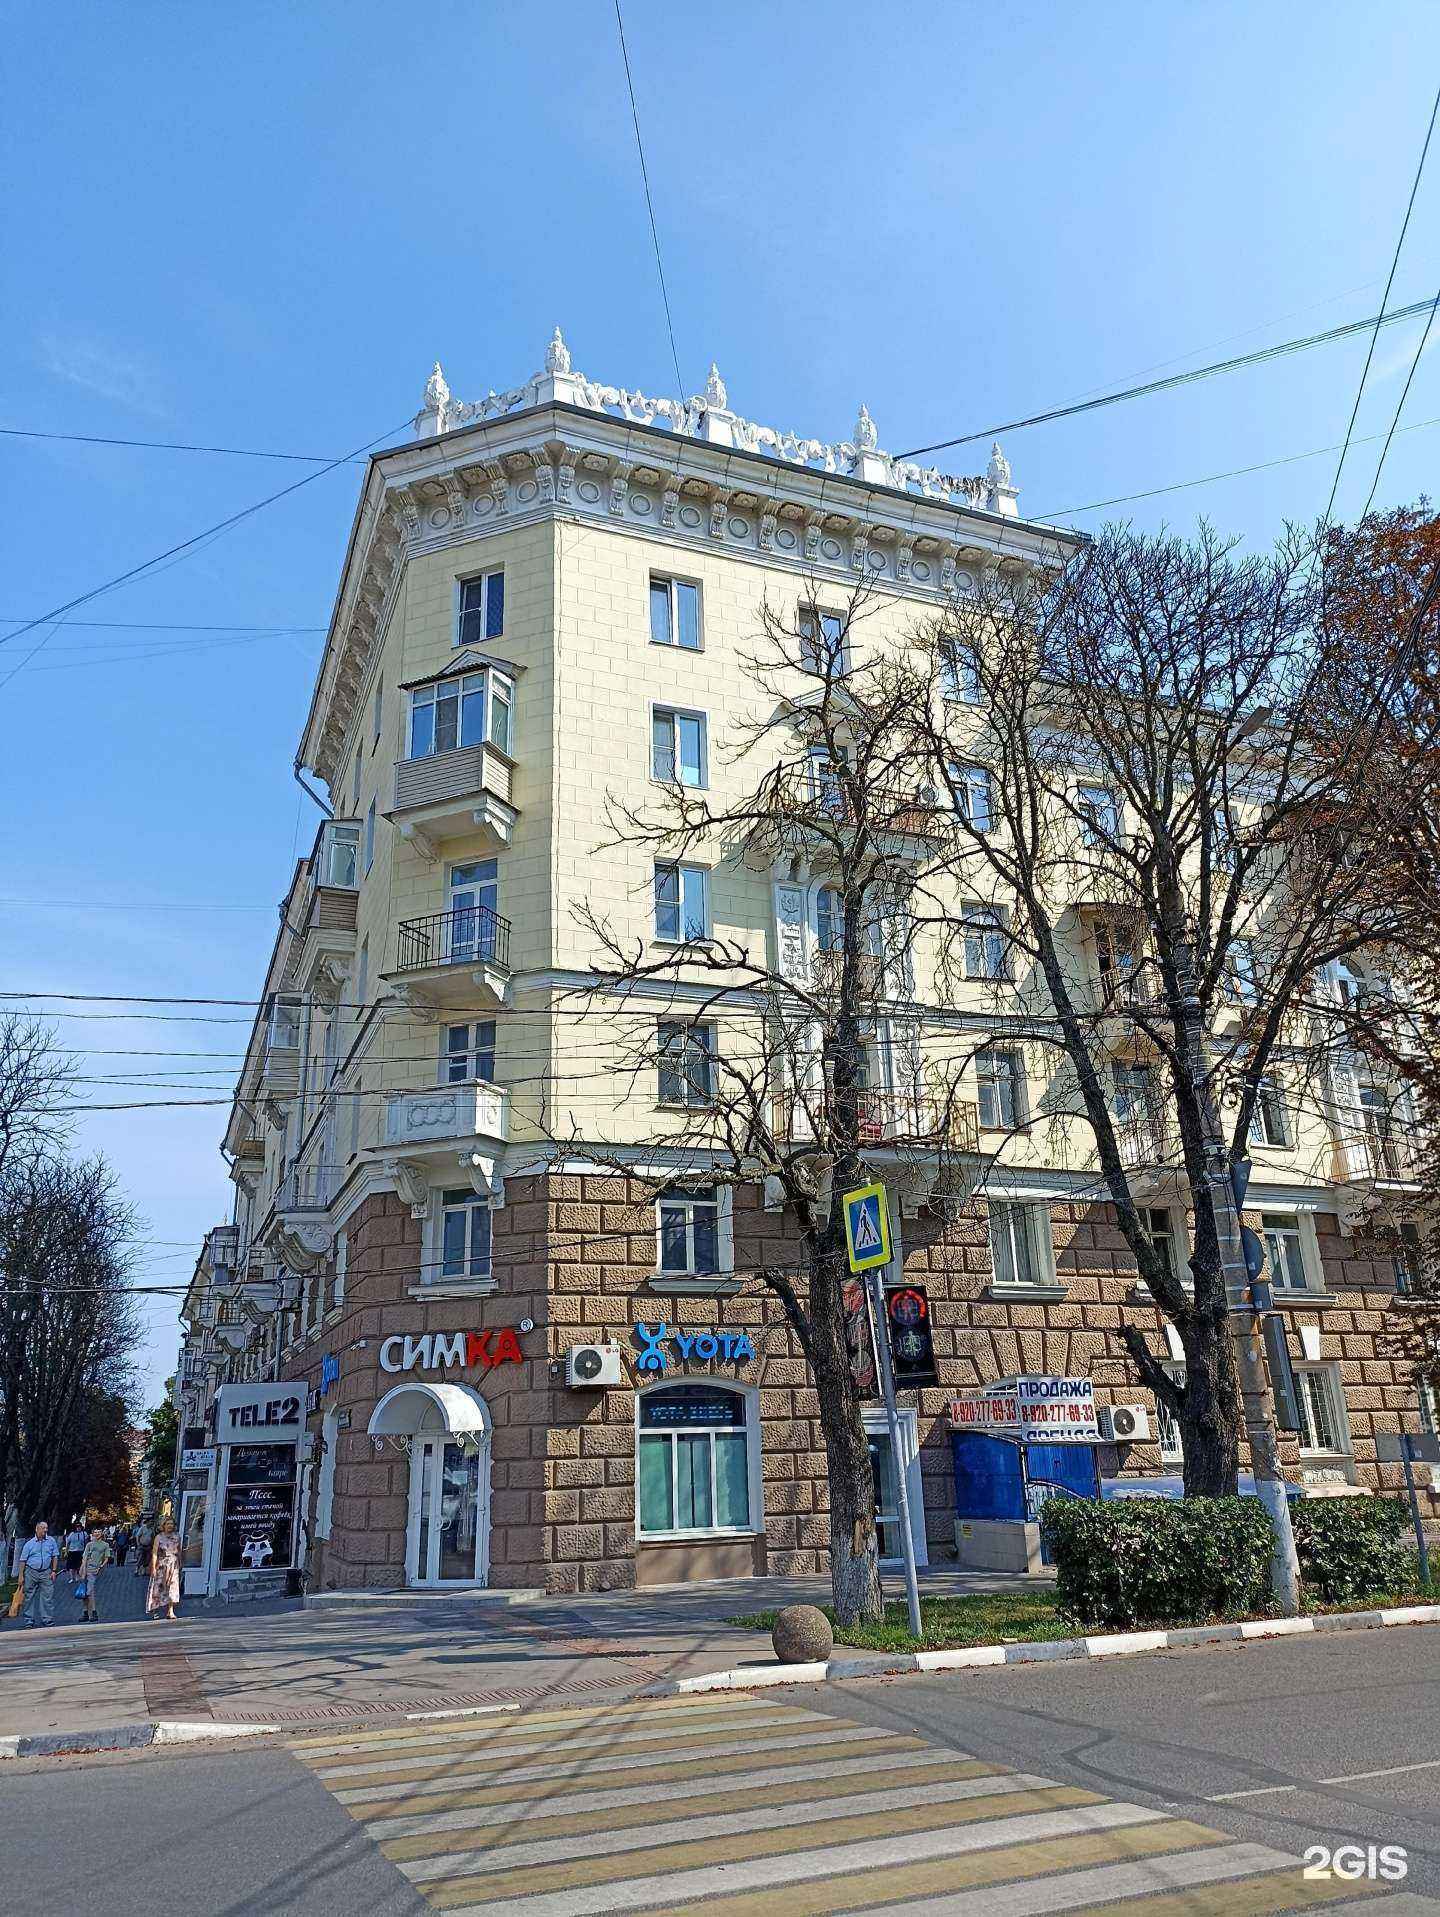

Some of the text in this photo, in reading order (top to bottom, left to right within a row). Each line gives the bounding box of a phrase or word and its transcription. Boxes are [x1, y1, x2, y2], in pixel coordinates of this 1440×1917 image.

[379, 1328, 524, 1373] СИМКА
[676, 1333, 756, 1360] YOTA
[1018, 1380, 1092, 1398] ПРОДАЖА
[228, 1396, 300, 1428] TELE2
[952, 1398, 1017, 1423] 8-920-277-69-33
